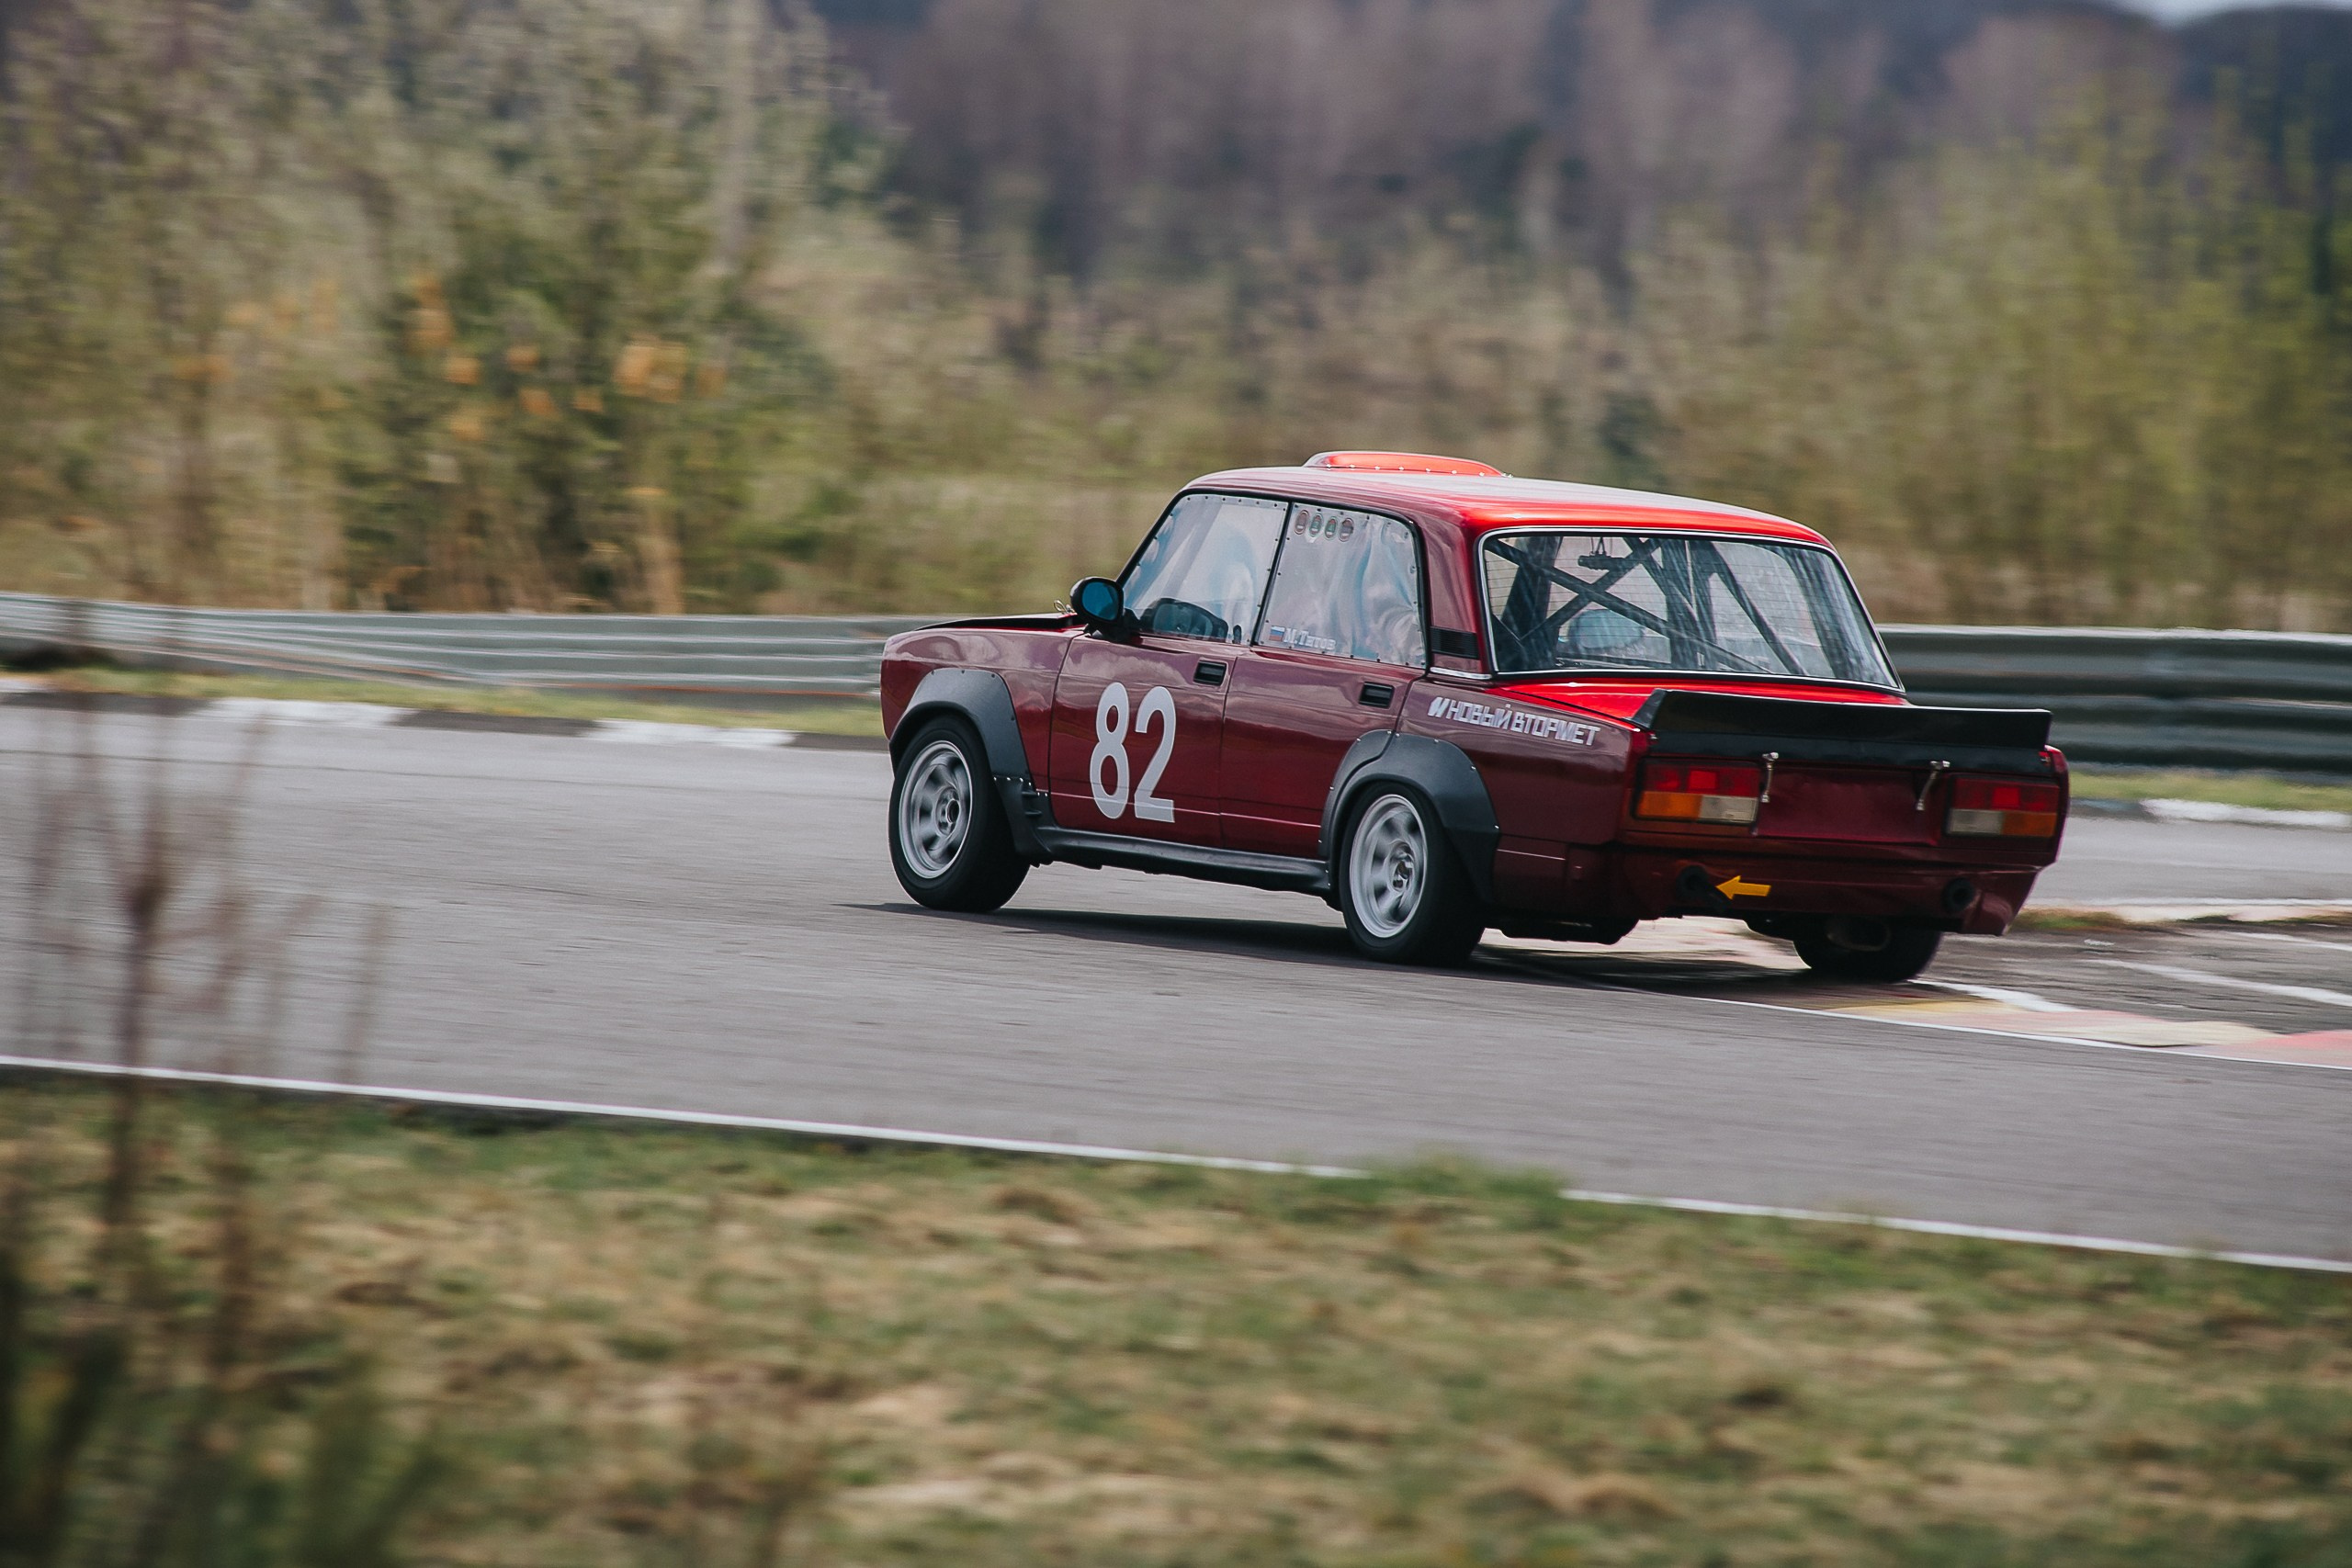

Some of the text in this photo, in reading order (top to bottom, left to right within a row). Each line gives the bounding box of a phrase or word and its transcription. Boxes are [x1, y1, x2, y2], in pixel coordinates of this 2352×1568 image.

[1090, 682, 1176, 823] 82
[1445, 700, 1600, 746] НОВЫЙ ВТОРМЕТ
